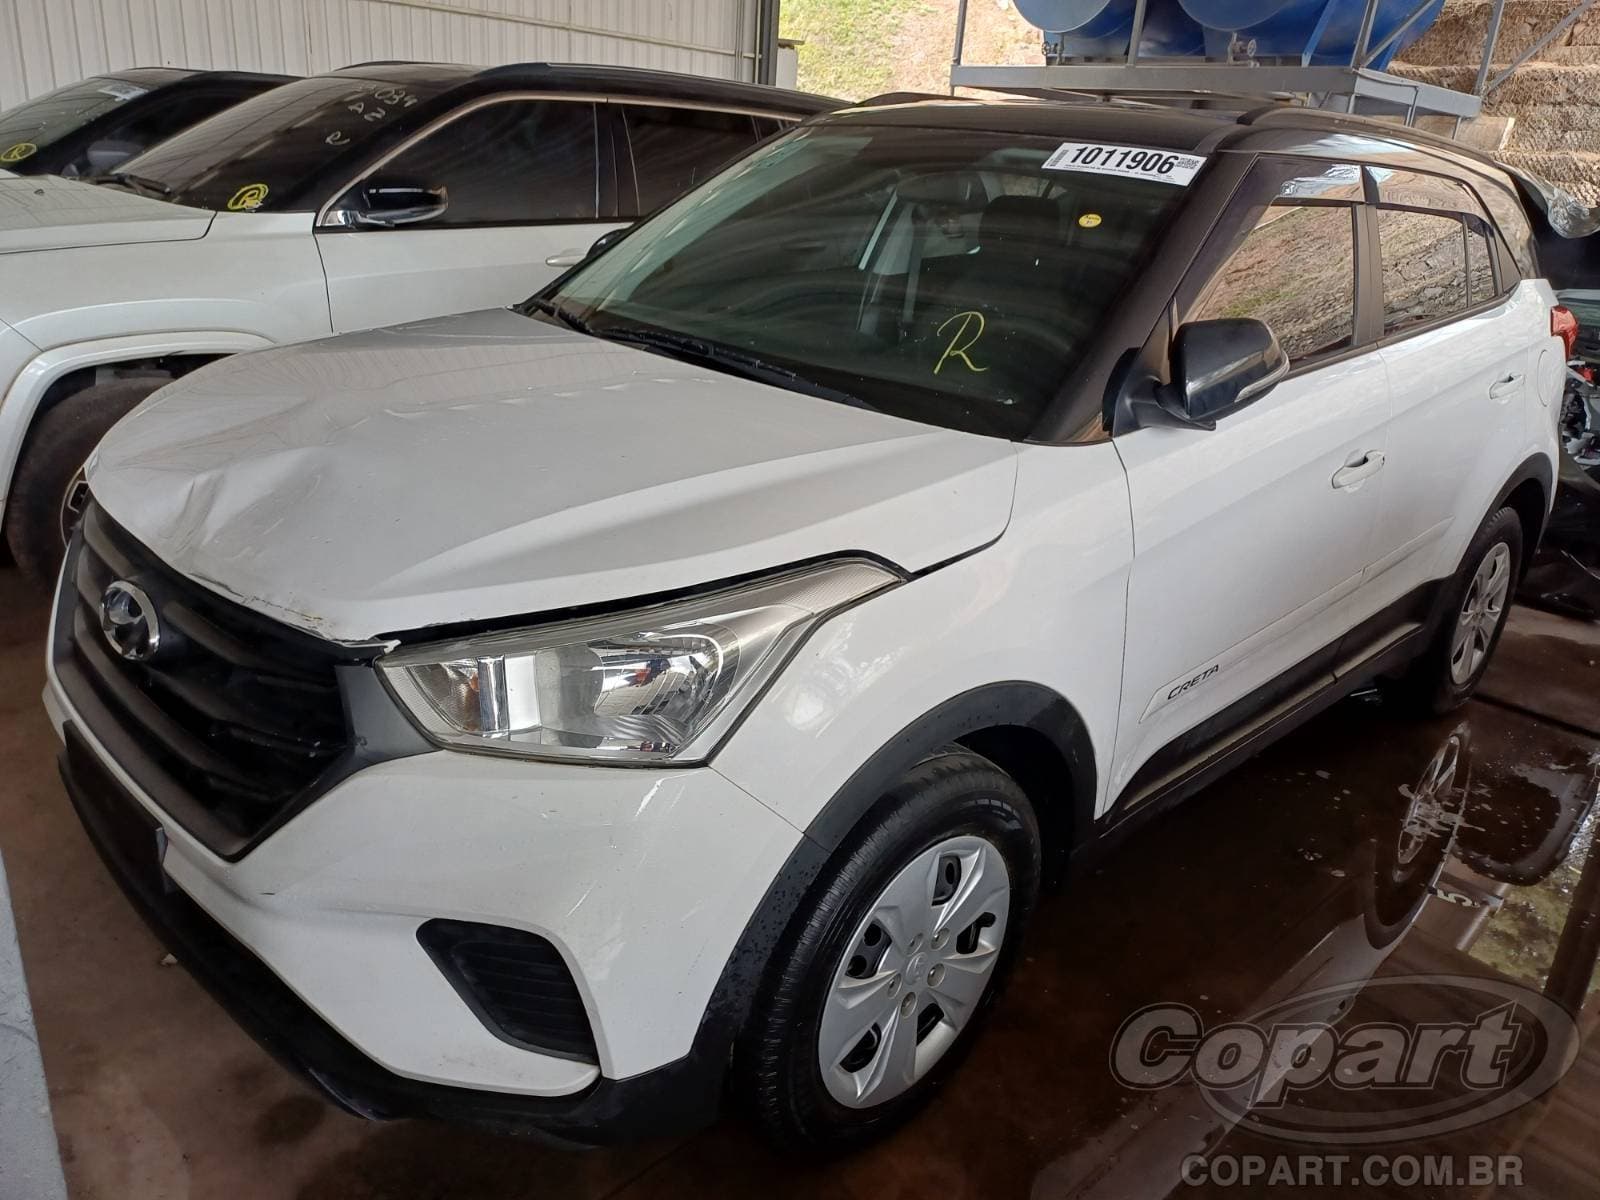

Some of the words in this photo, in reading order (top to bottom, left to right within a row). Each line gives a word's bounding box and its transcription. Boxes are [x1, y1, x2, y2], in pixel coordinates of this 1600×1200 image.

[1071, 146, 1180, 175] 1011906
[933, 311, 988, 374] R
[1167, 664, 1219, 700] CRETA
